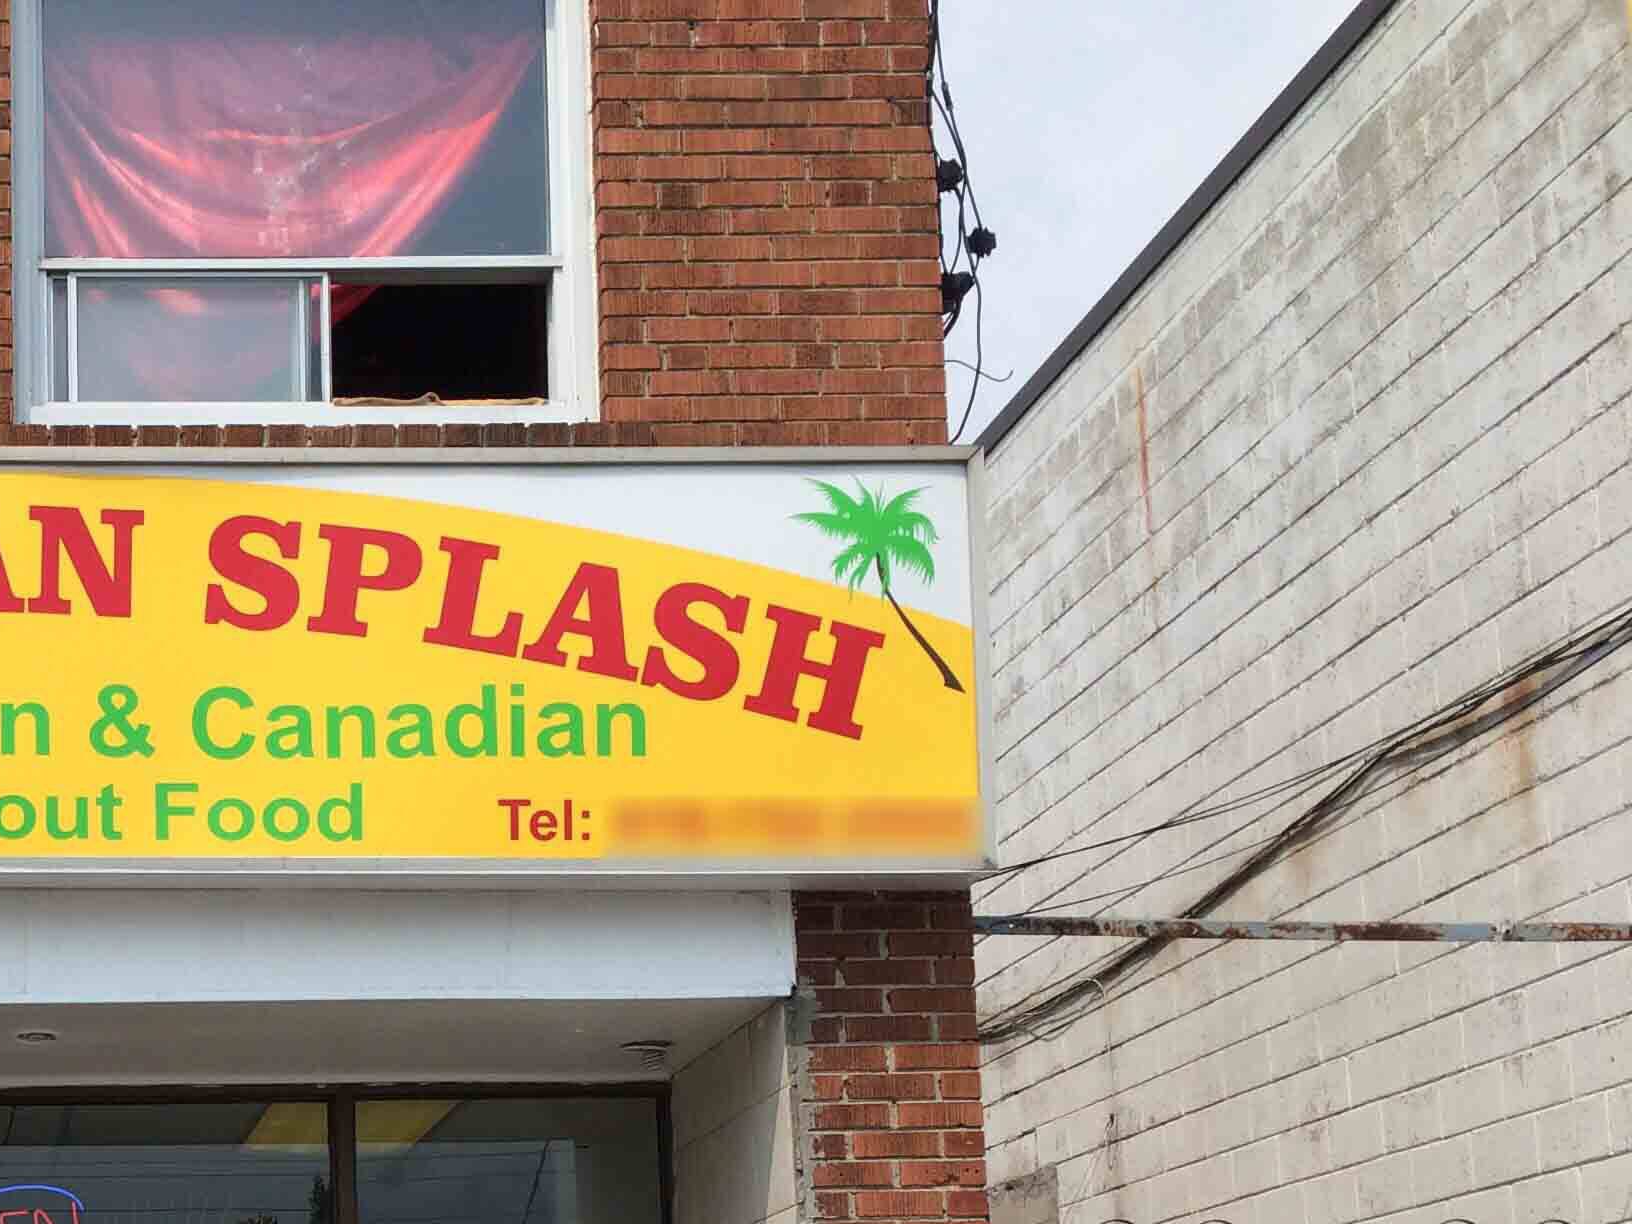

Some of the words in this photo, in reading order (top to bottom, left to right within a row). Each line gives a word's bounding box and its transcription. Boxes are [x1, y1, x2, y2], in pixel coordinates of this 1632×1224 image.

[204, 515, 886, 741] SPLASH
[89, 684, 155, 757] &
[191, 683, 648, 759] Canadian
[154, 782, 364, 842] Food
[498, 799, 593, 842] Tel:
